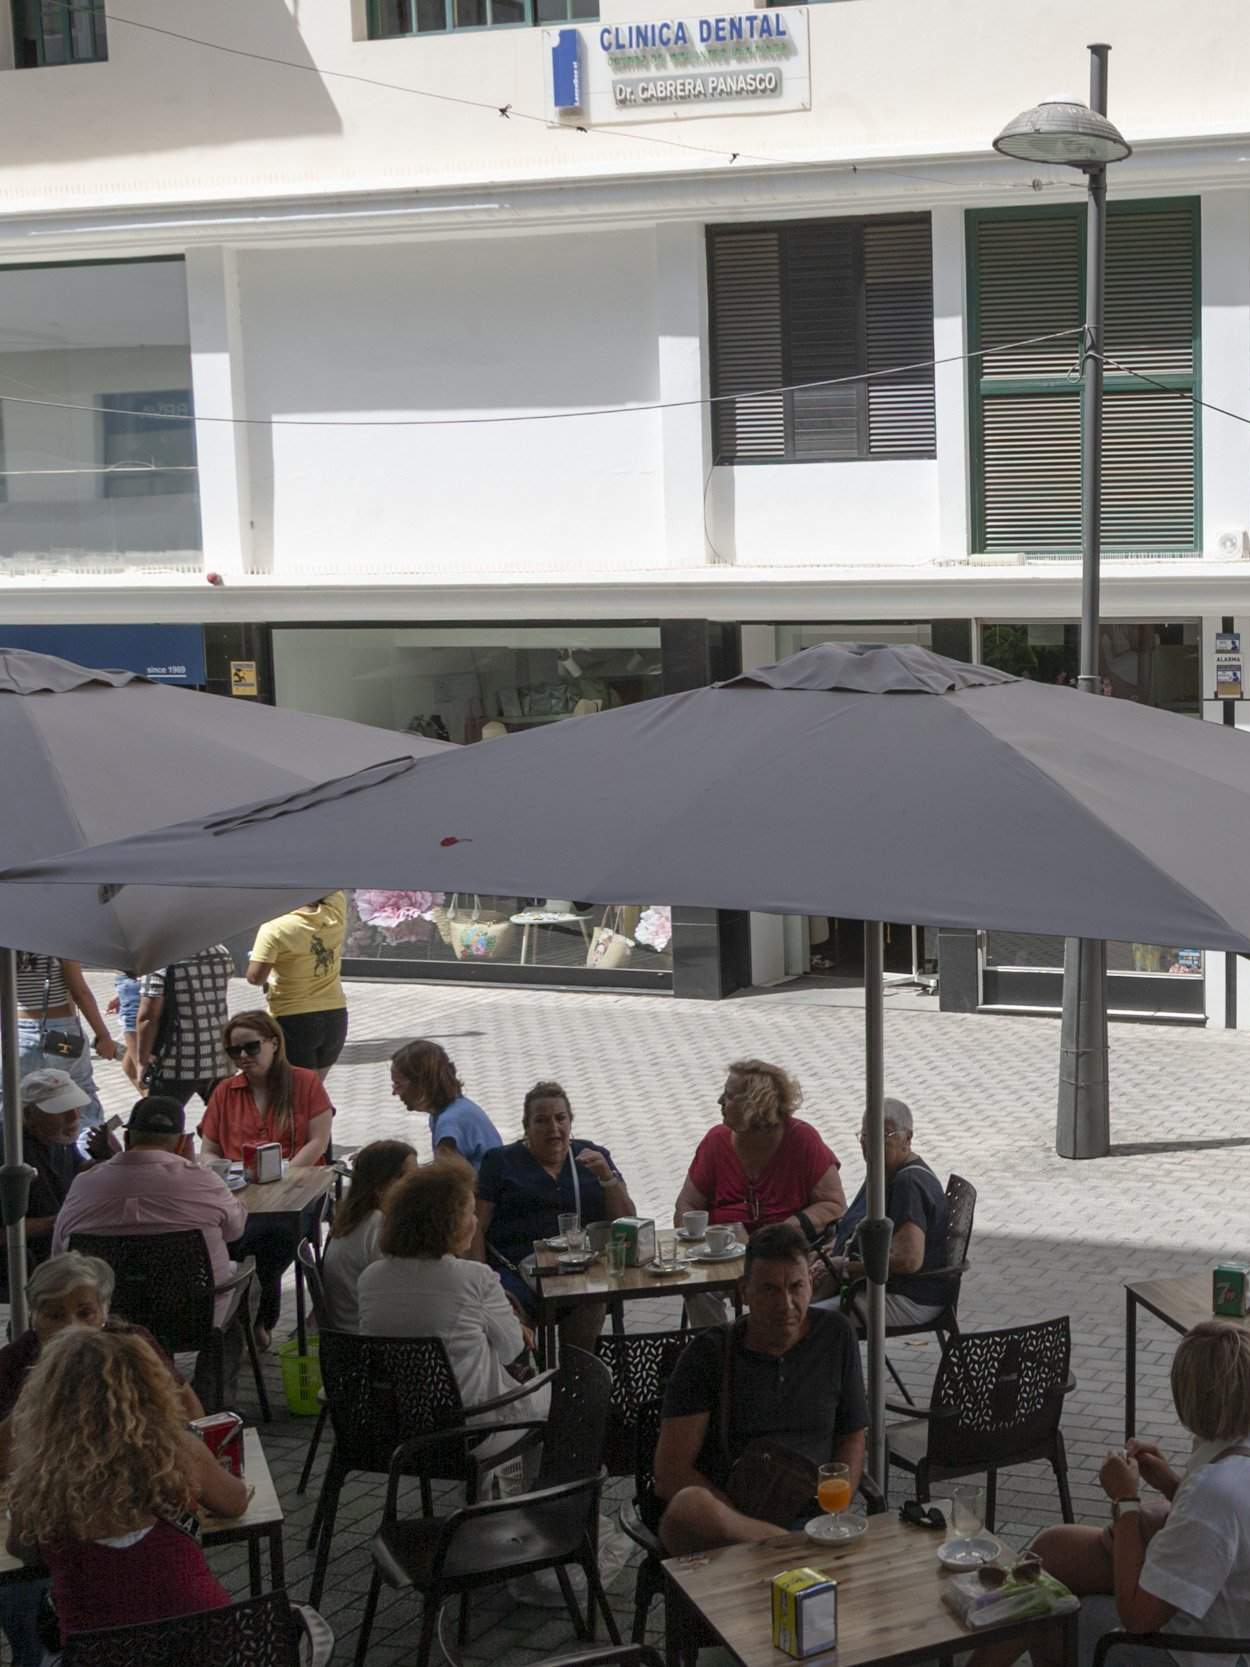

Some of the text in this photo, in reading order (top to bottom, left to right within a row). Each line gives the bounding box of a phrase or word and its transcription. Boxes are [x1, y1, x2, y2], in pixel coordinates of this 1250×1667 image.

[600, 13, 787, 51] CLINICA DENTAL
[616, 72, 777, 100] Dr. CABRERA PANASCO
[147, 665, 167, 674] since
